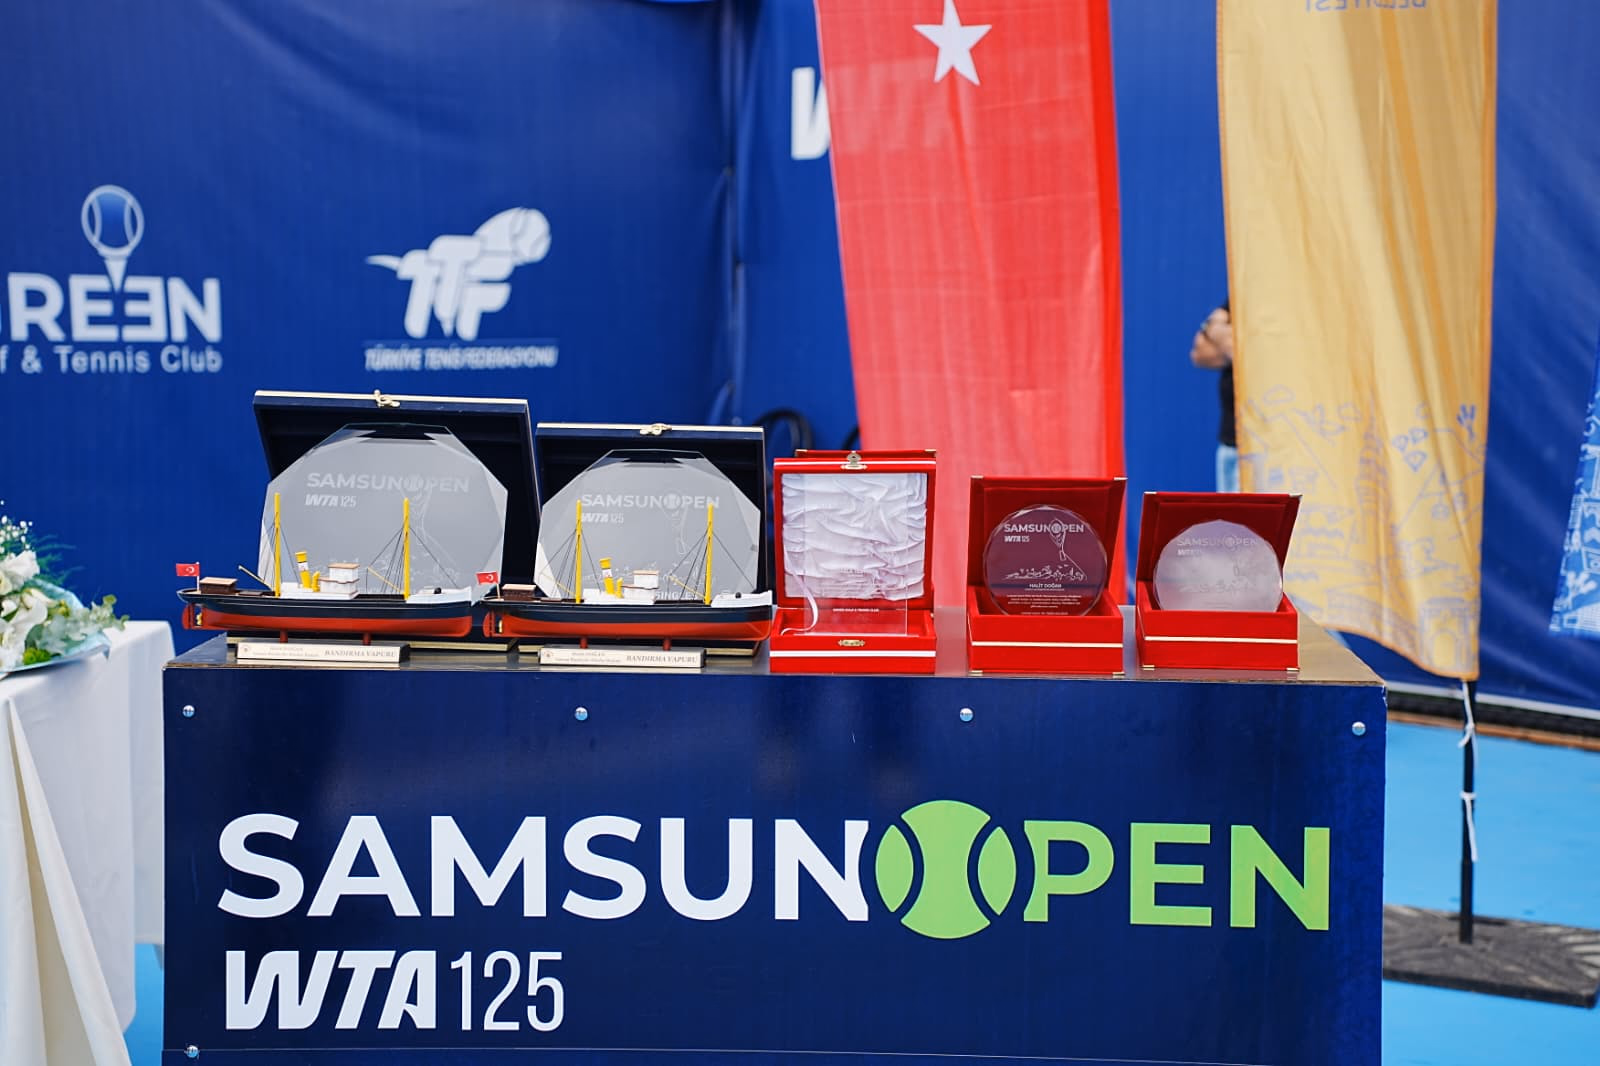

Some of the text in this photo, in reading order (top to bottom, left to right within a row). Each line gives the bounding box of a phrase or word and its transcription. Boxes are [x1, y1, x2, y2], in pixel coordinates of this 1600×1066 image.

[0, 271, 222, 343] REEN
[21, 345, 42, 374] &
[53, 345, 150, 374] Tennis
[160, 345, 223, 373] Club
[304, 494, 339, 507] WTA
[225, 951, 564, 1032] WTA 125
